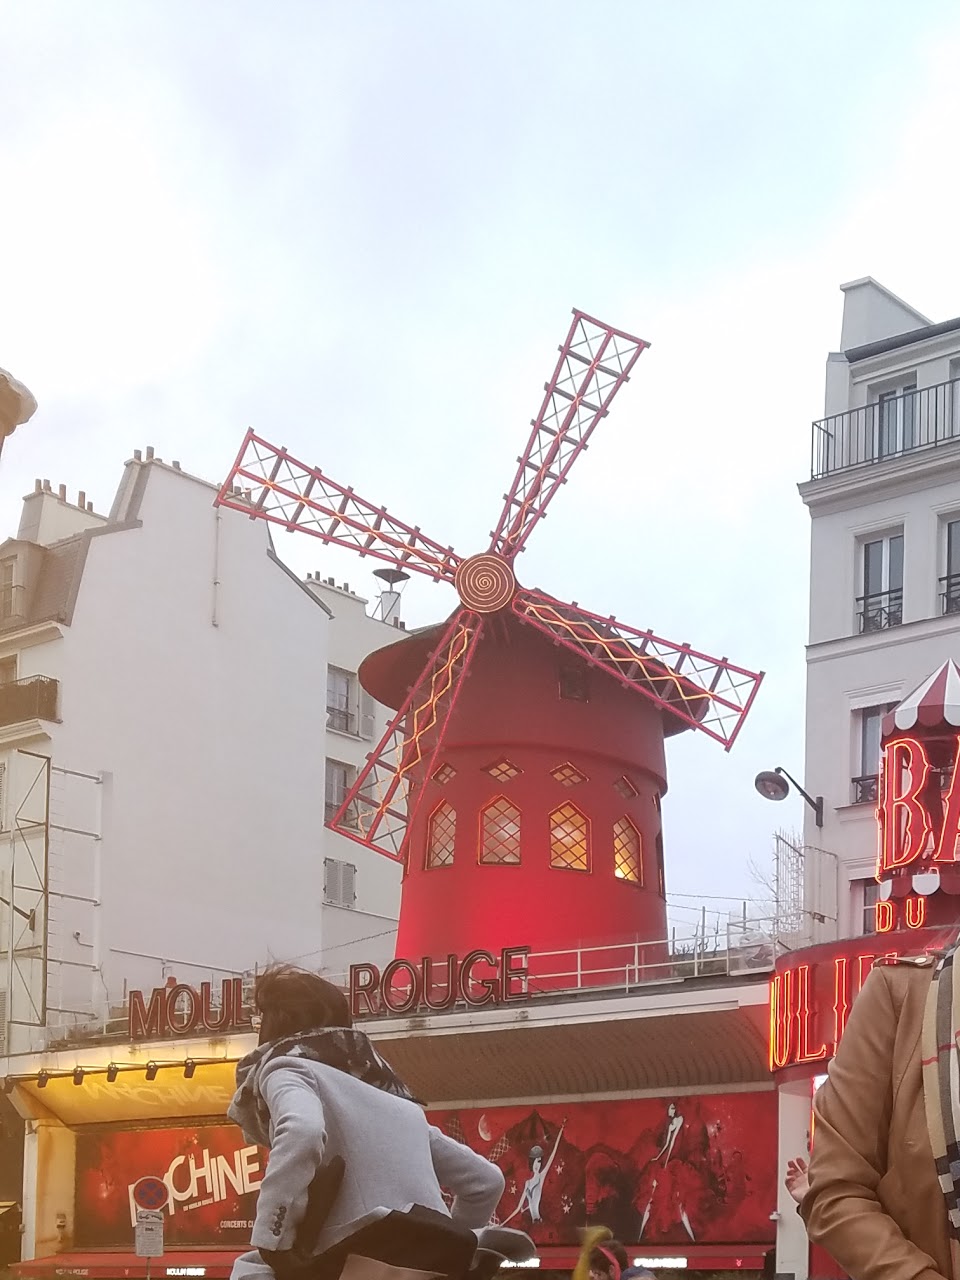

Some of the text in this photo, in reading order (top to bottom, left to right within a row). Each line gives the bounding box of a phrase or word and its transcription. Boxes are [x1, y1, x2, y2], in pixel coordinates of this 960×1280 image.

[875, 898, 925, 933] DU
[129, 945, 531, 1041] MOUL ROUGE
[127, 1145, 262, 1228] CHINE
[220, 1220, 247, 1229] CONCERTS
